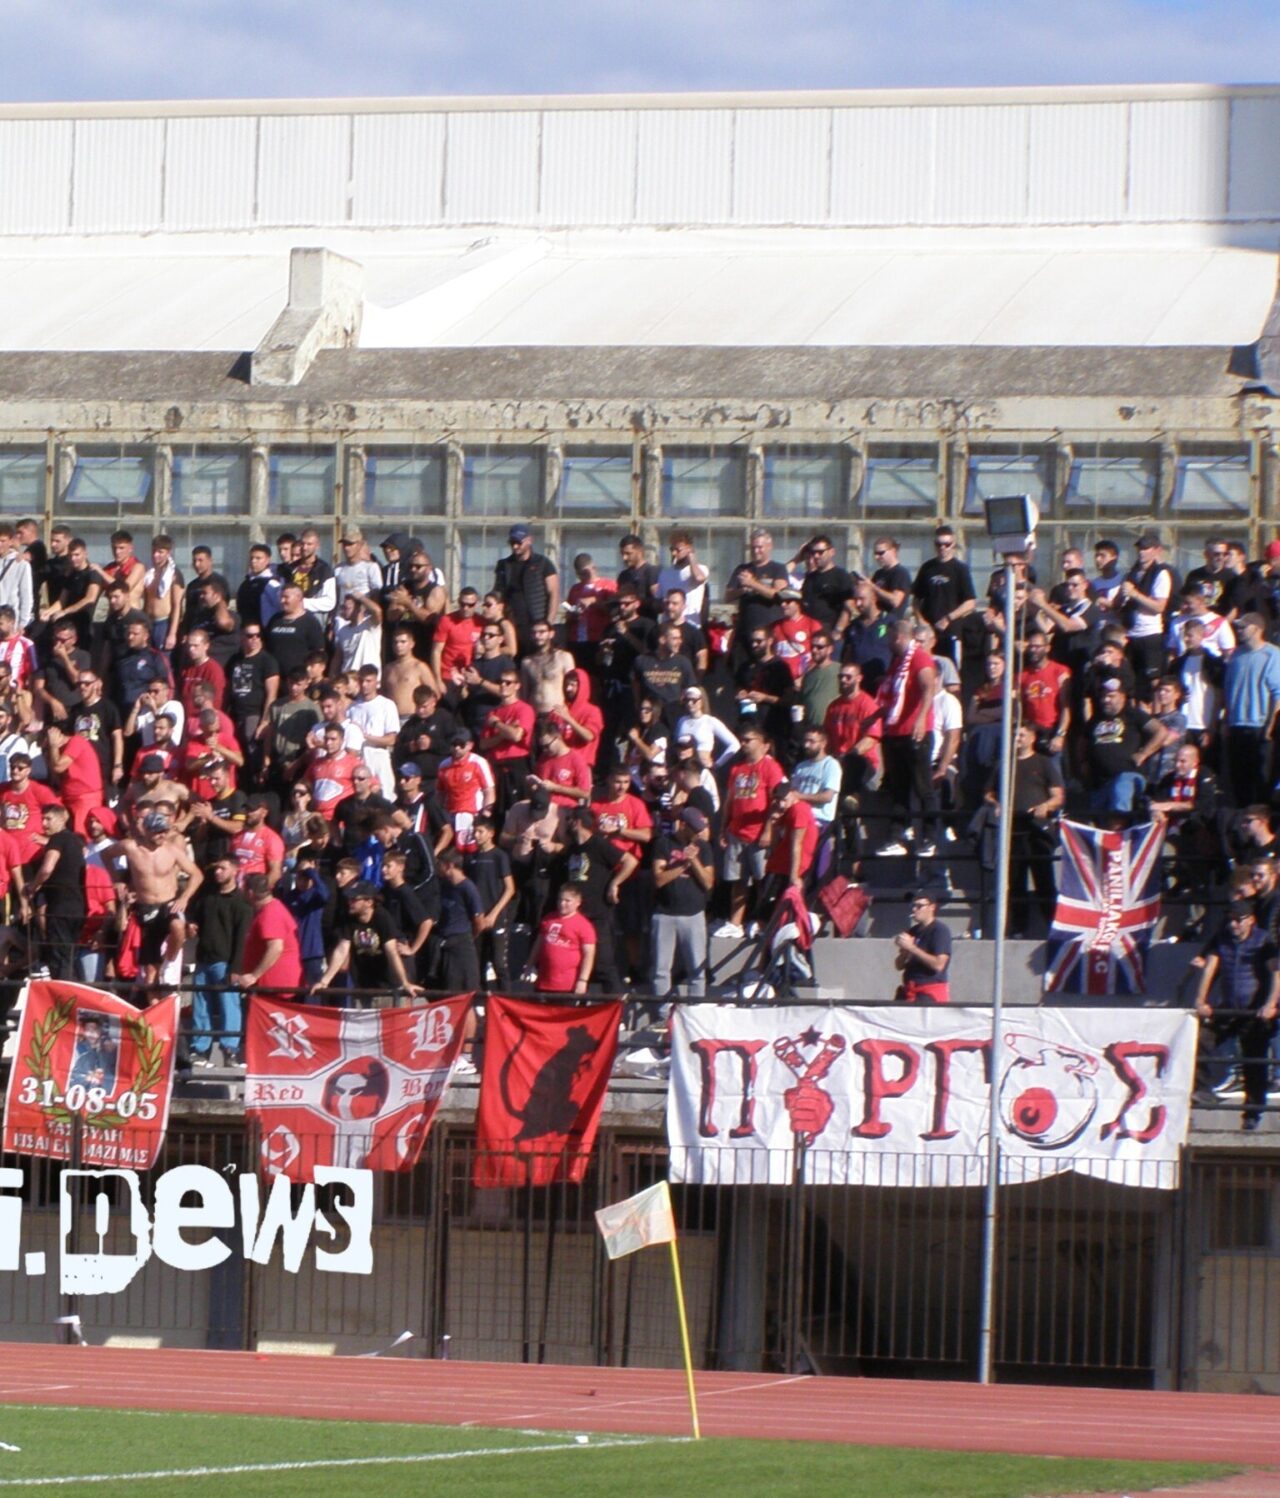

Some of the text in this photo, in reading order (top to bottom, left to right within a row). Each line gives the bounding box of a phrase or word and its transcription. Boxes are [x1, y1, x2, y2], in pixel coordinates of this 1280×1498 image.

[267, 1005, 454, 1060] R B
[18, 1076, 159, 1120] 31-08-05
[252, 1082, 304, 1102] Red
